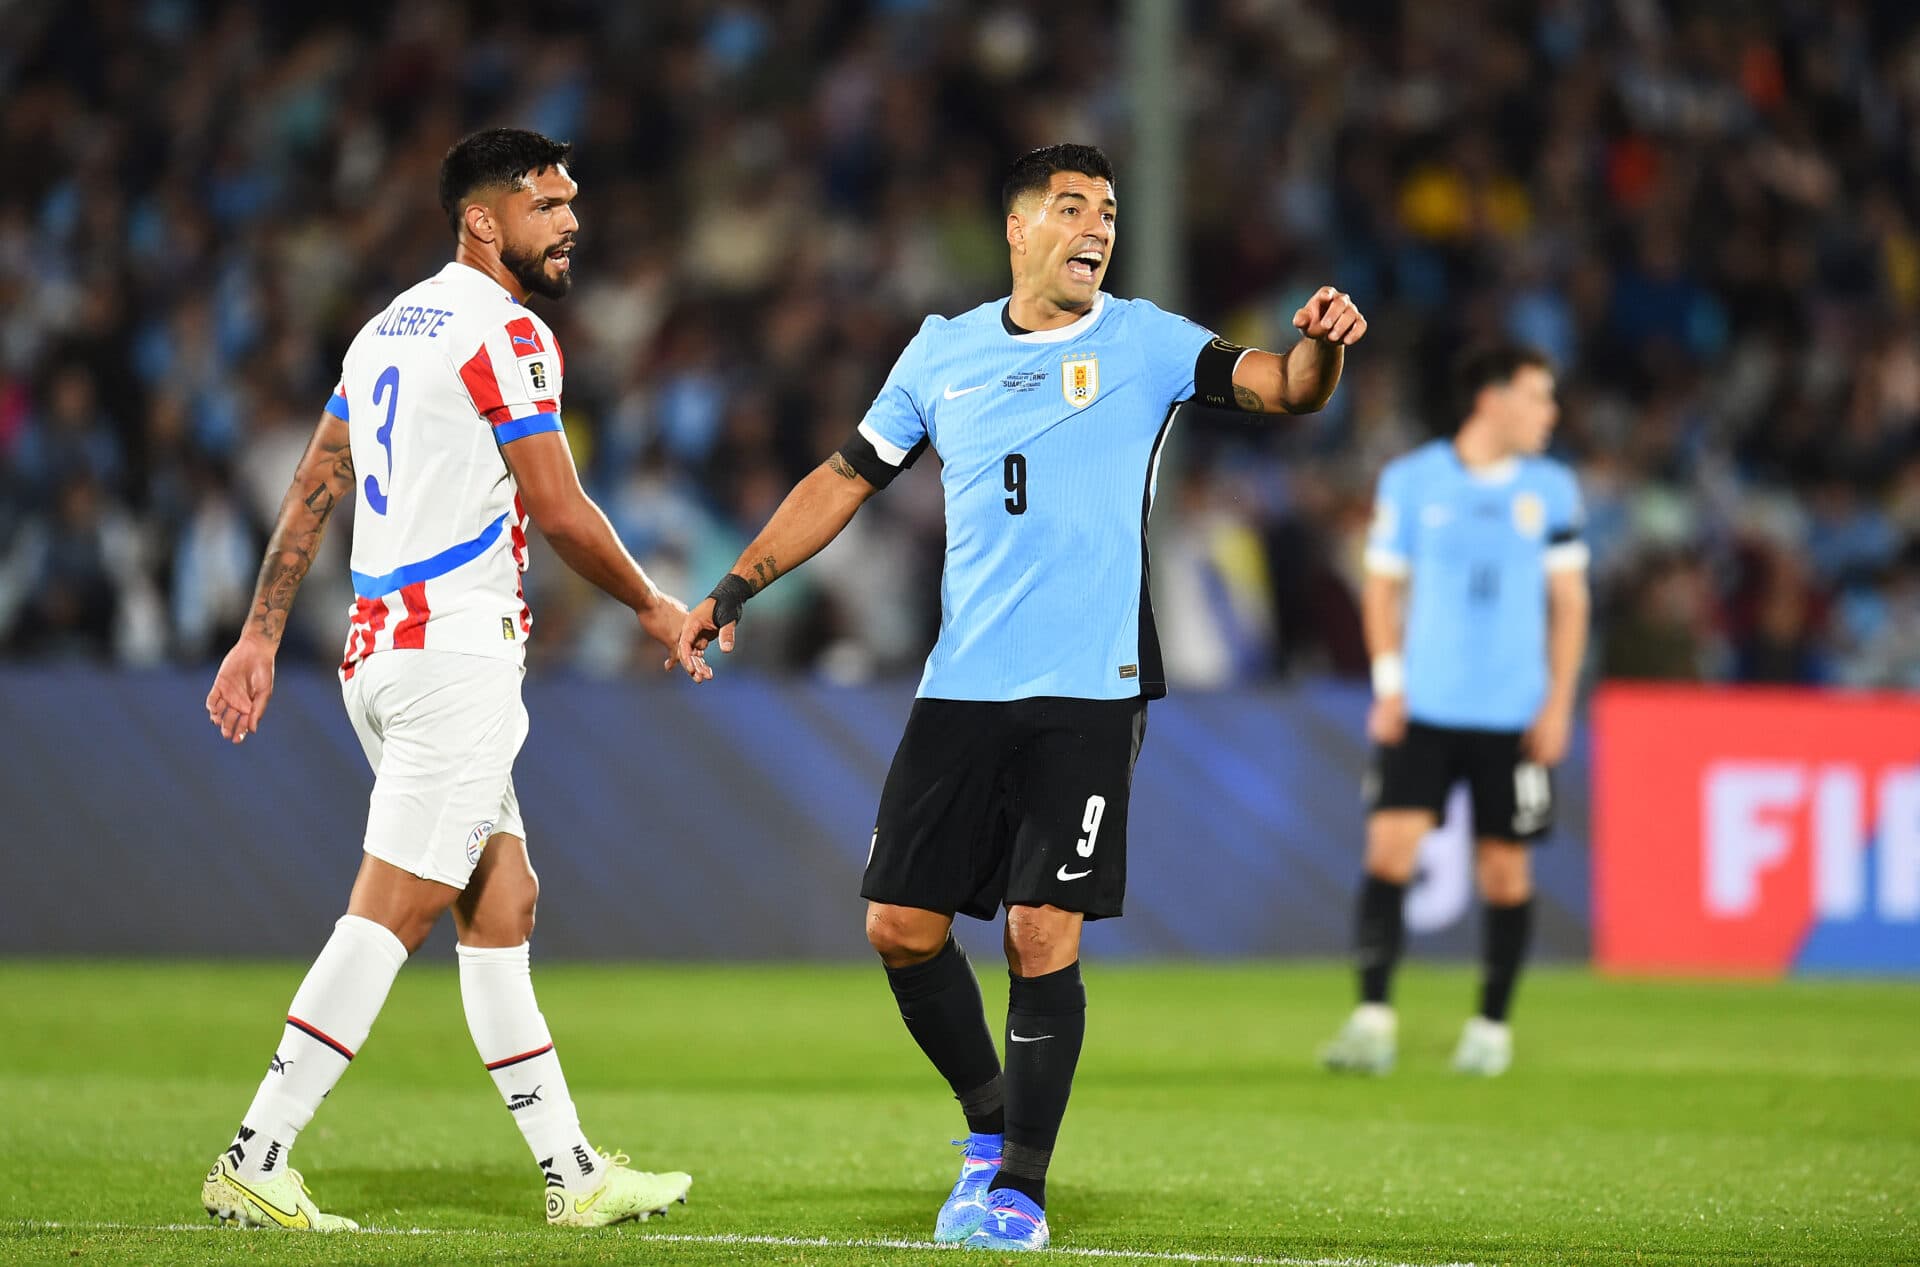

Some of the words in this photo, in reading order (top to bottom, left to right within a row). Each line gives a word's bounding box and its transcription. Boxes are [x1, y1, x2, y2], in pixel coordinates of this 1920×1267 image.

[364, 366, 400, 516] 3
[1004, 453, 1027, 516] 9
[1076, 794, 1106, 858] 9
